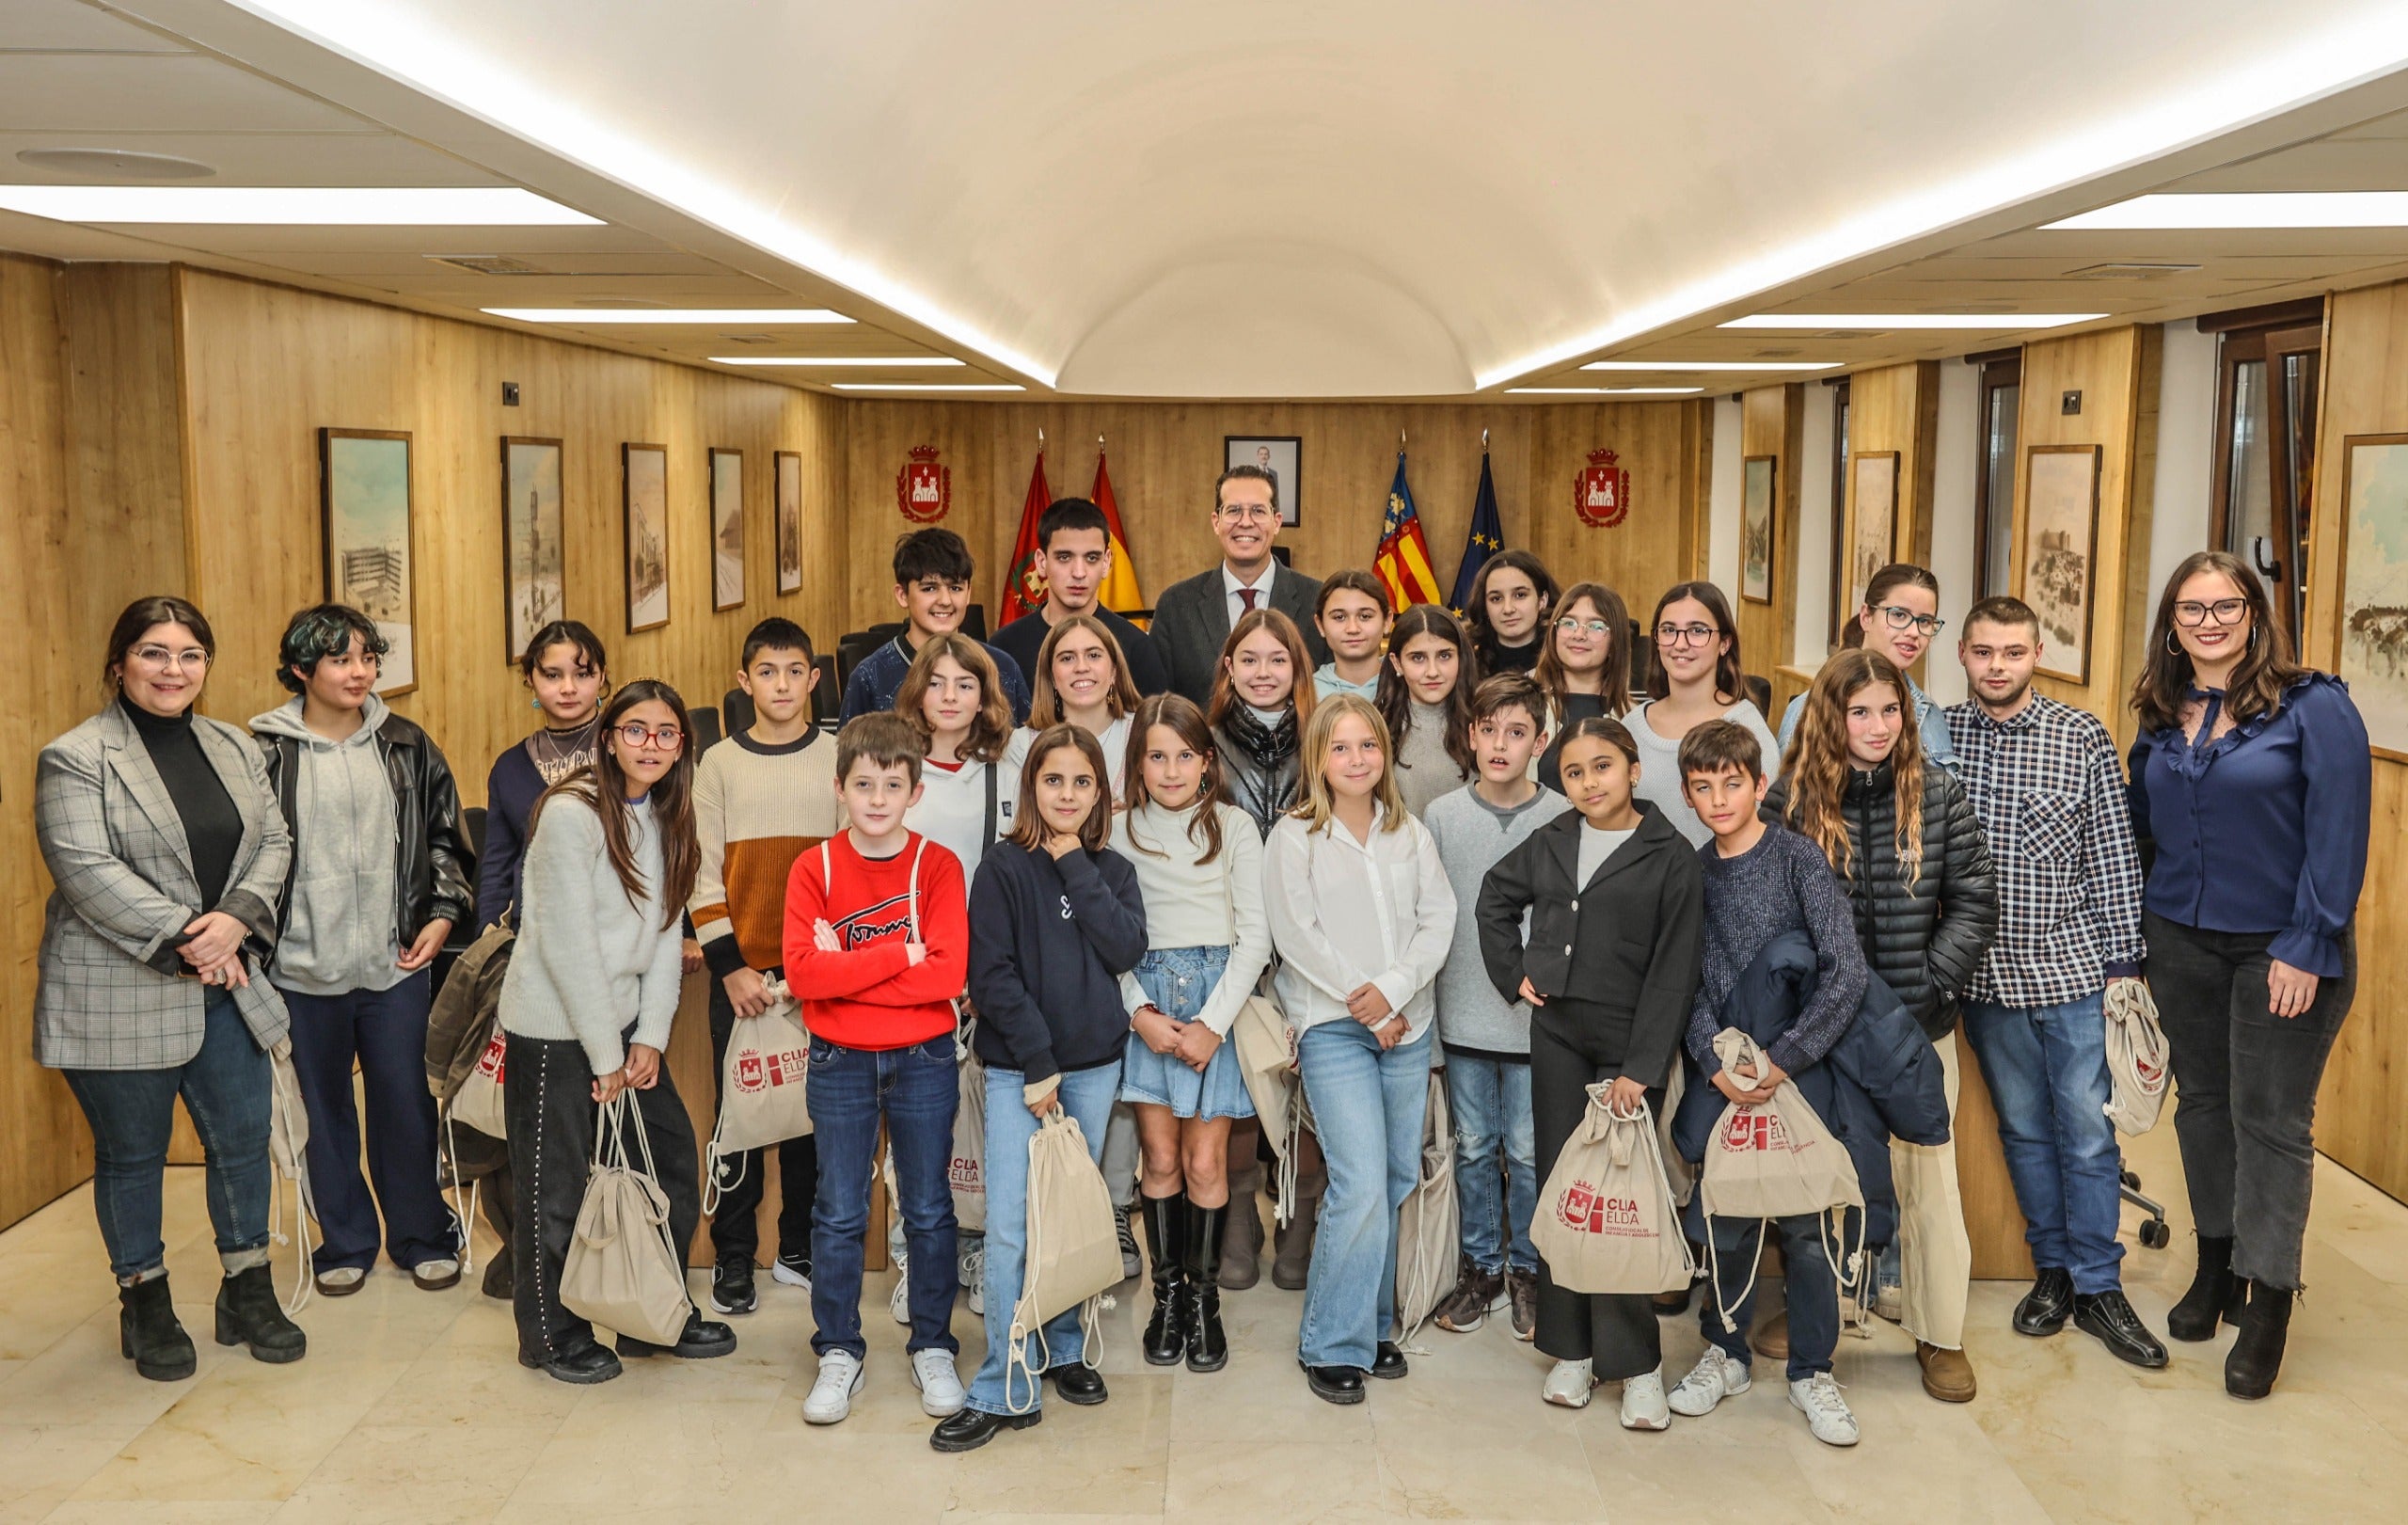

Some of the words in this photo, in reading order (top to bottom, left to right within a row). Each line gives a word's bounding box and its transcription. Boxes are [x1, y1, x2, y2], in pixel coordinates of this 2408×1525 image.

[781, 1047, 809, 1062] CLIA
[784, 1059, 806, 1073] ELD
[951, 1168, 978, 1182] ELDA
[1607, 1198, 1639, 1213] CLIA
[1607, 1211, 1640, 1225] ELDA
